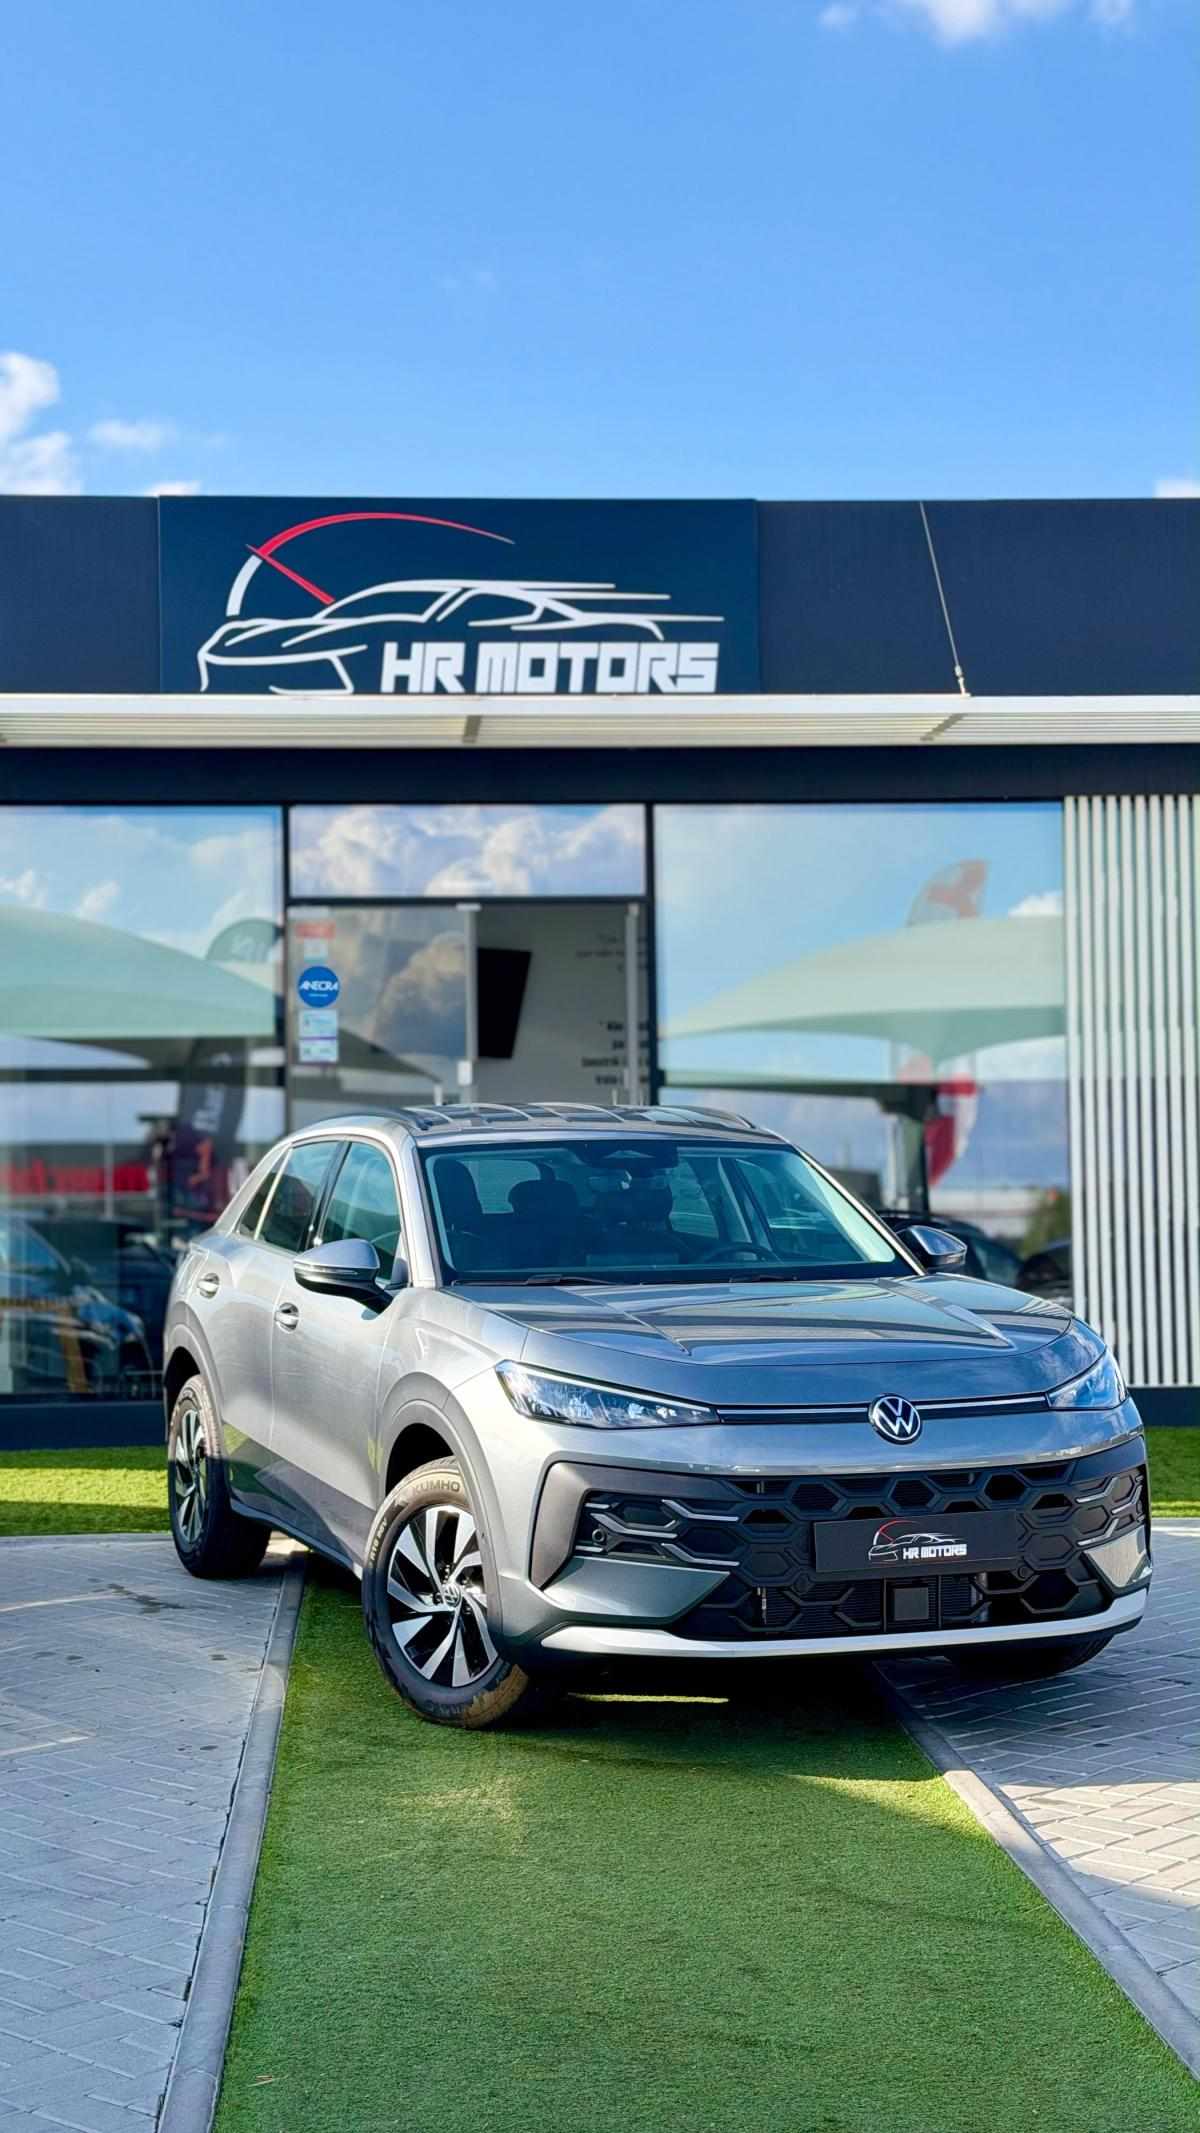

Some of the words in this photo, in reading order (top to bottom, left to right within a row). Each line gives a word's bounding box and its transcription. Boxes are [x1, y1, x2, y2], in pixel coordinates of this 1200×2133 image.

[380, 642, 465, 693] HR
[475, 642, 719, 693] MOTORS
[903, 1547, 920, 1559] HR
[921, 1544, 967, 1558] MOTORS
